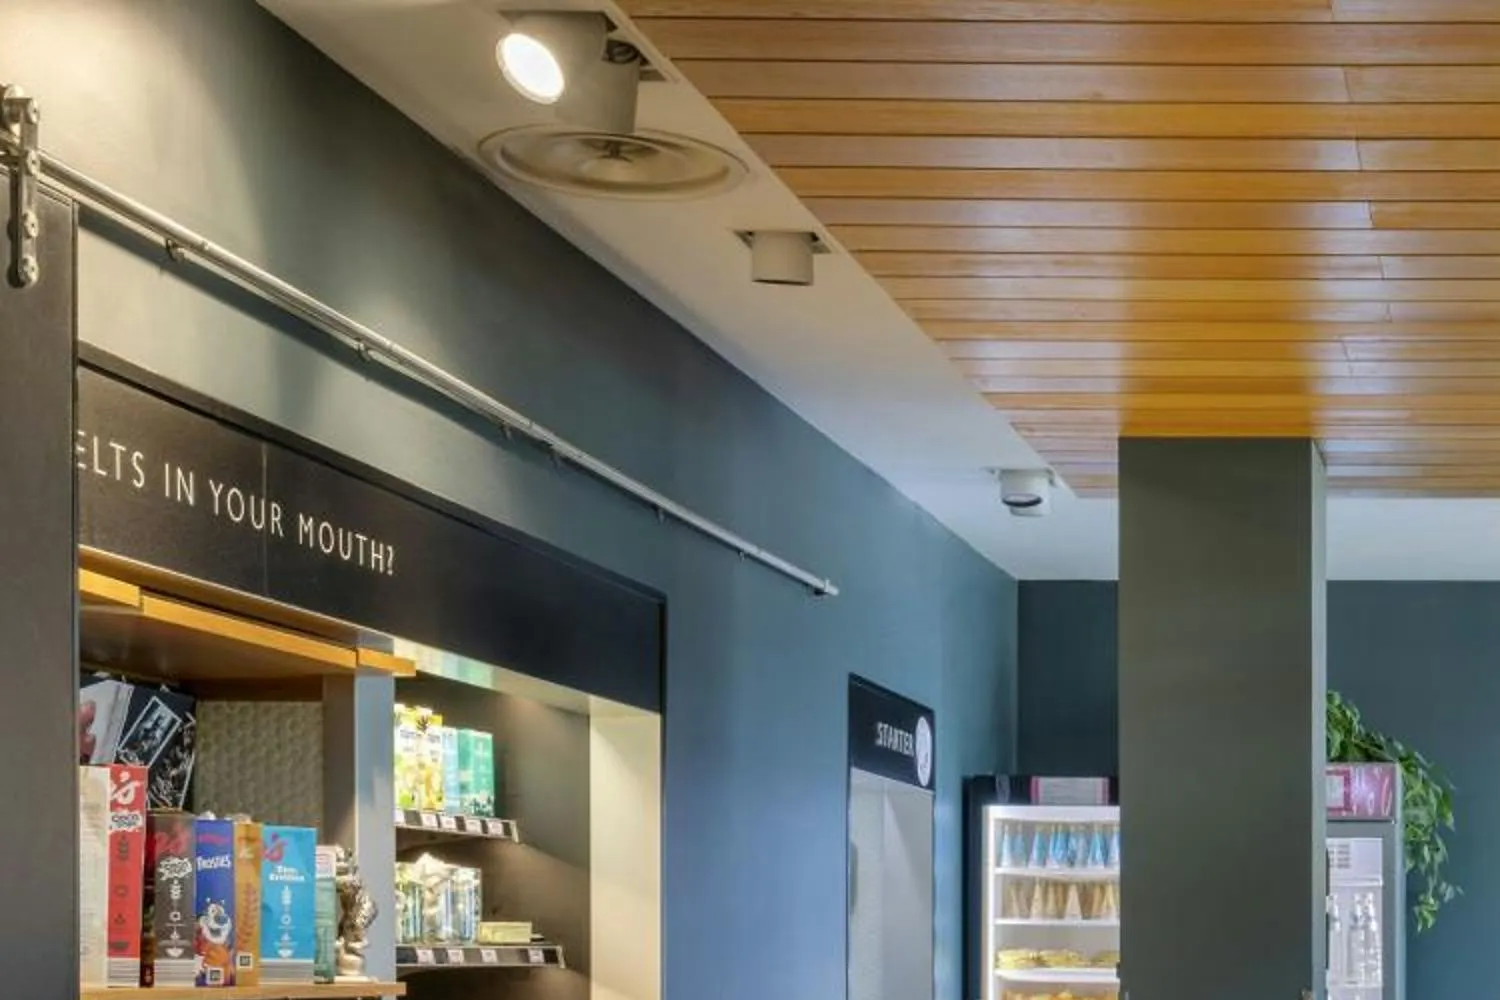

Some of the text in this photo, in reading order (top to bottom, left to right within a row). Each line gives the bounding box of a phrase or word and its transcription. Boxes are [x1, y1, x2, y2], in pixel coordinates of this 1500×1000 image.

[165, 463, 195, 506] IN
[209, 479, 284, 539] YOUR
[299, 512, 394, 576] MOUTH?
